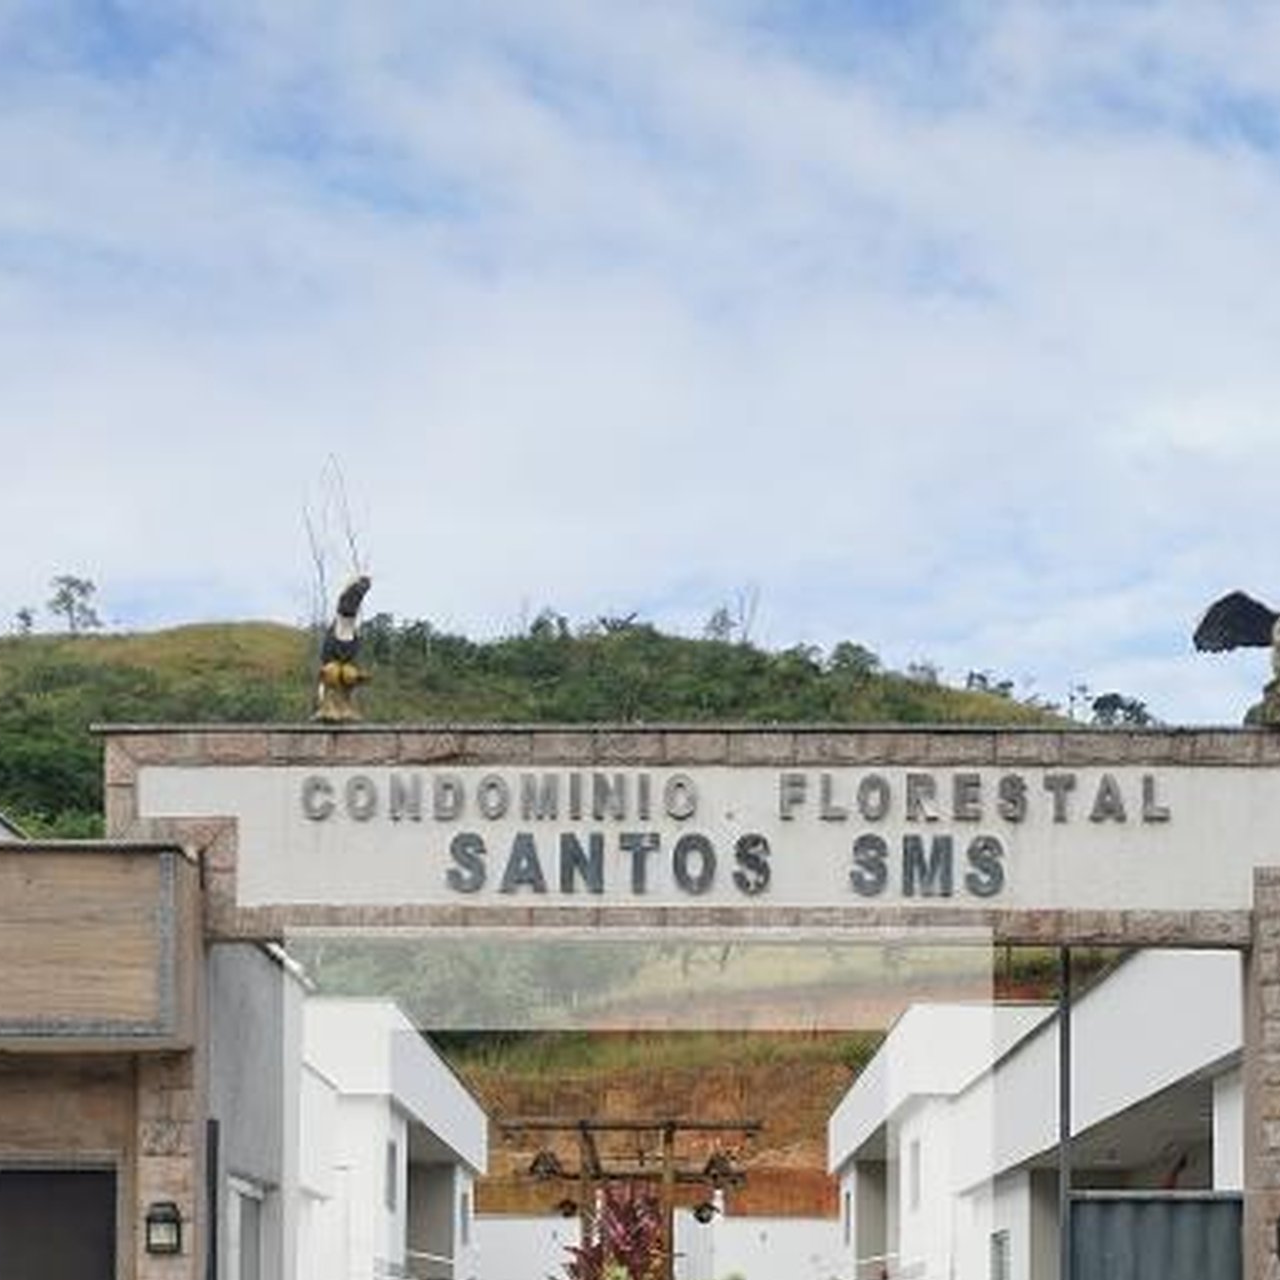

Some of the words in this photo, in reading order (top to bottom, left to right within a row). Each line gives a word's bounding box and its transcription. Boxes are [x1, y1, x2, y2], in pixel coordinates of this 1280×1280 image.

[300, 773, 697, 822] CONDOMINIO
[778, 773, 1171, 824] FLORESTAL
[445, 832, 772, 897] SANTOS
[849, 833, 1006, 898] SMS
